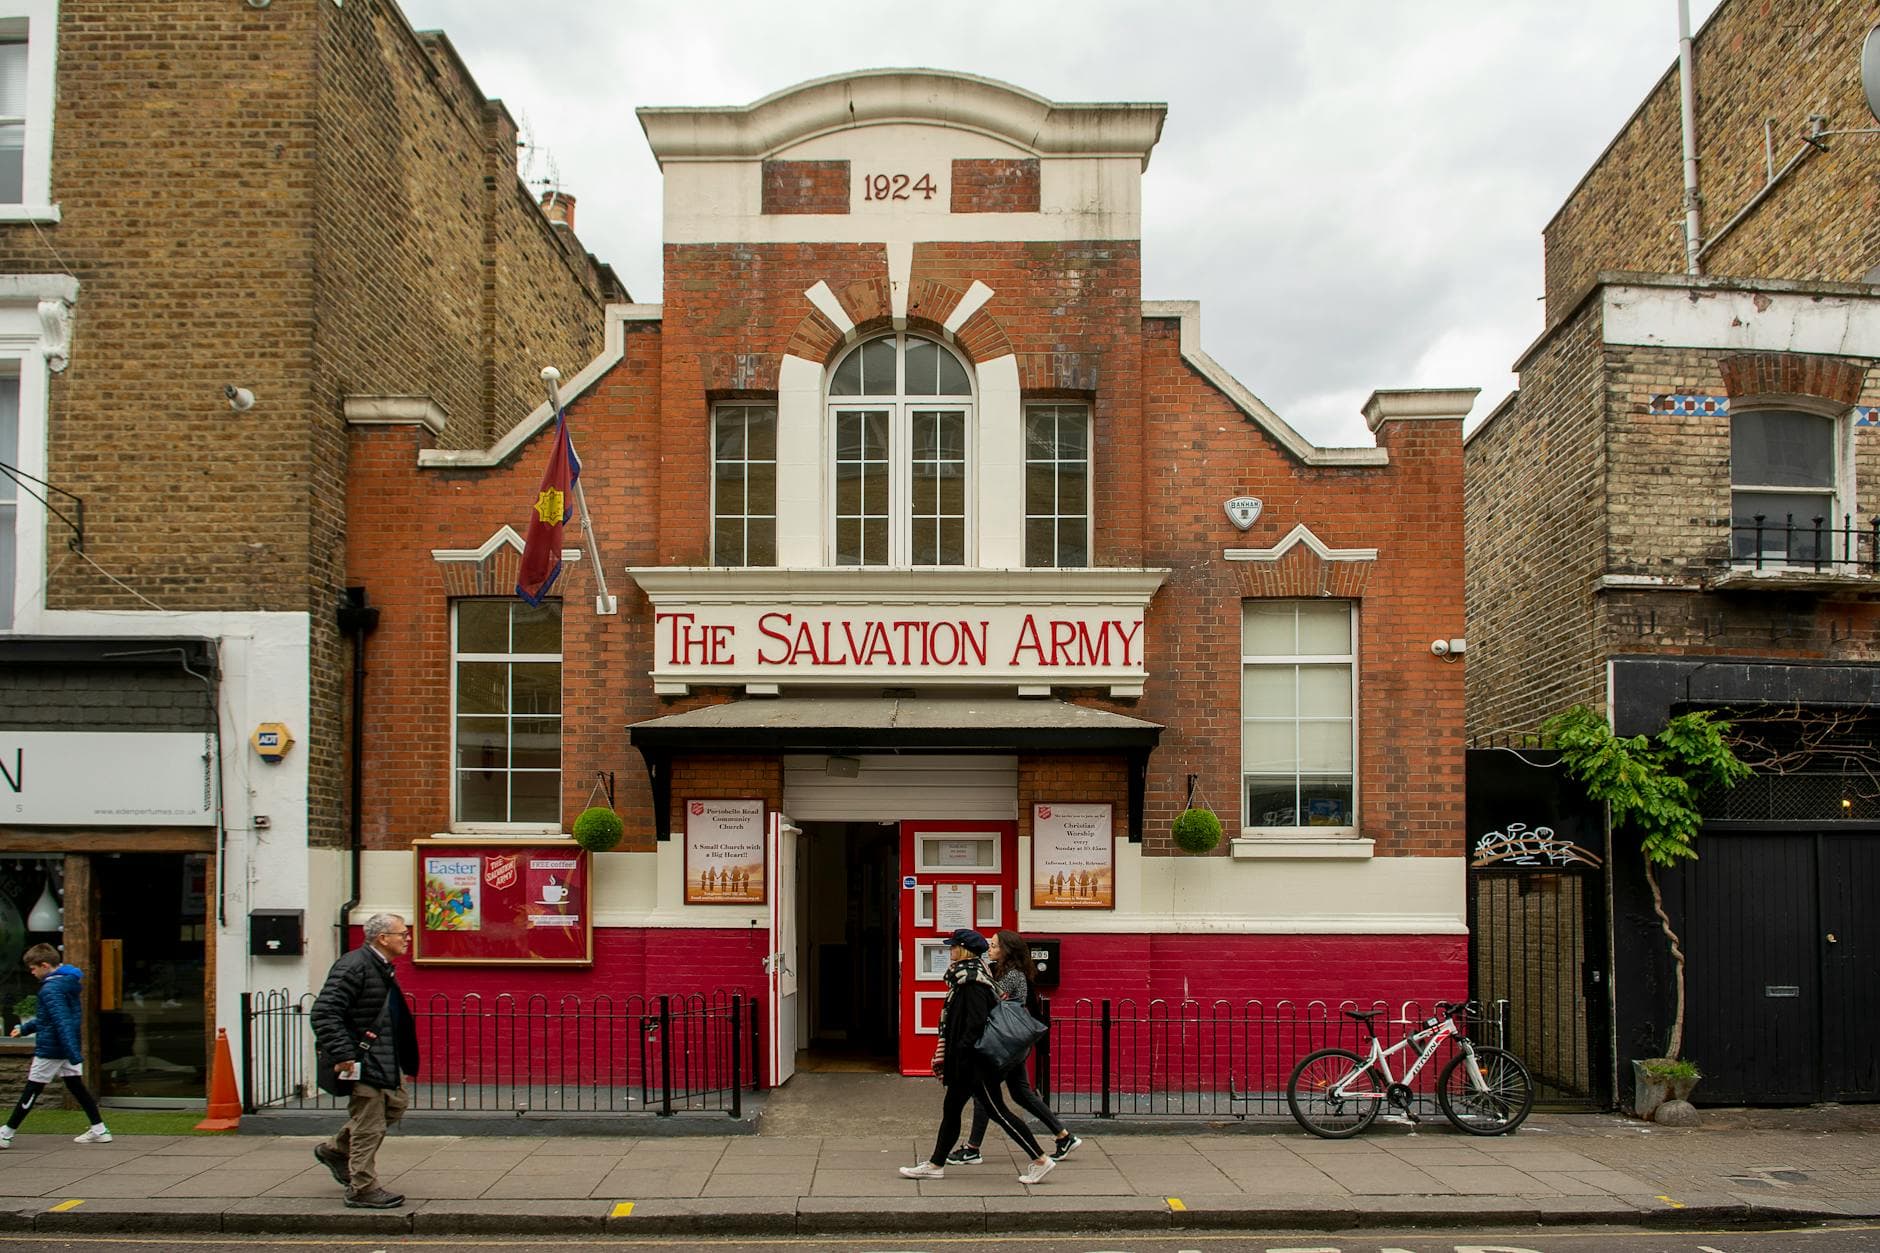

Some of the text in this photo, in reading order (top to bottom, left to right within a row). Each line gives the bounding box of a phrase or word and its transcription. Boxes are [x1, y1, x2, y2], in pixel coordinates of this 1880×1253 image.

[864, 173, 937, 201] 1924
[655, 612, 1143, 667] THE SALVATION ARMY.
[259, 735, 278, 744] ADT
[94, 808, 197, 816] www.edenperfumes.co.uk
[429, 860, 477, 875] Easter
[490, 858, 505, 870] THE
[495, 869, 514, 887] ARMY
